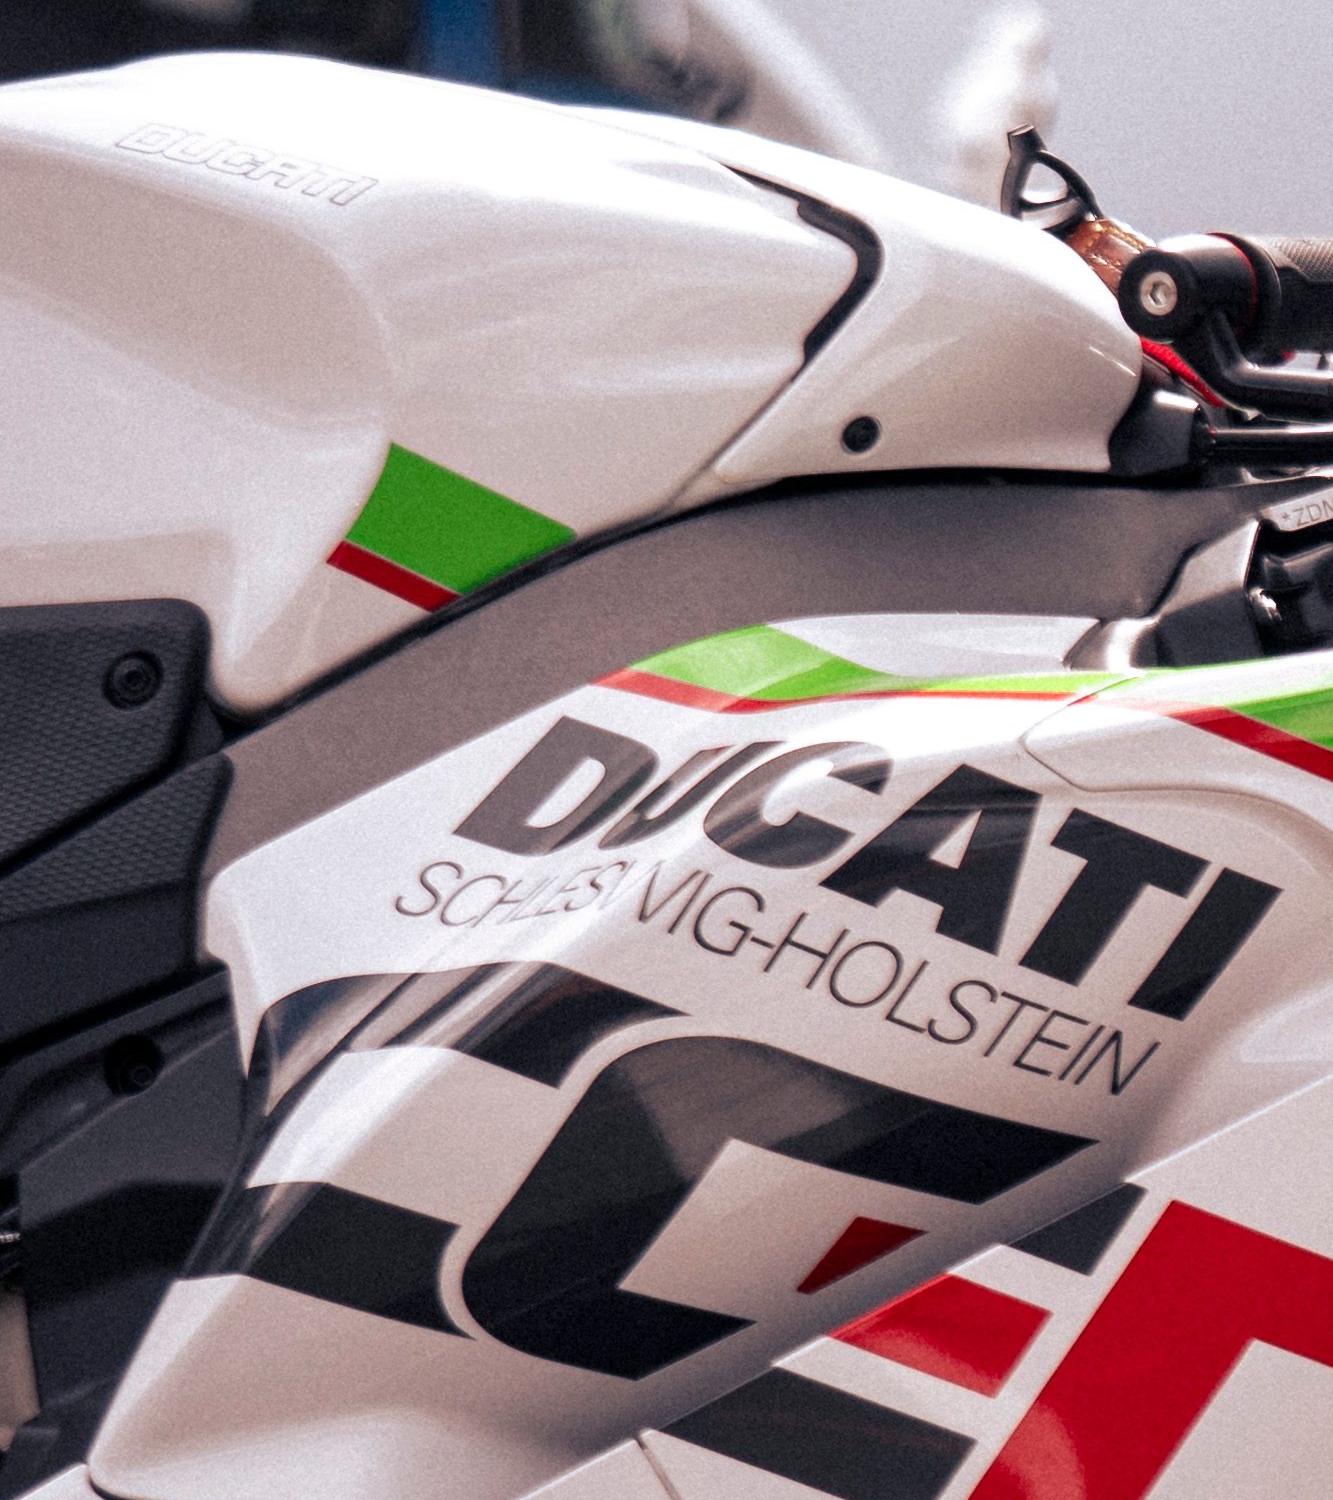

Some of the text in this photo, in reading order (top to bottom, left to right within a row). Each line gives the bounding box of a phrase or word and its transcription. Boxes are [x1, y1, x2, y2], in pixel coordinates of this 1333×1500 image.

[115, 122, 379, 206] DUCATI
[395, 859, 1160, 1096] SCHLESWIG-HOLSTEIN
[453, 716, 1283, 1021] DUCATI
